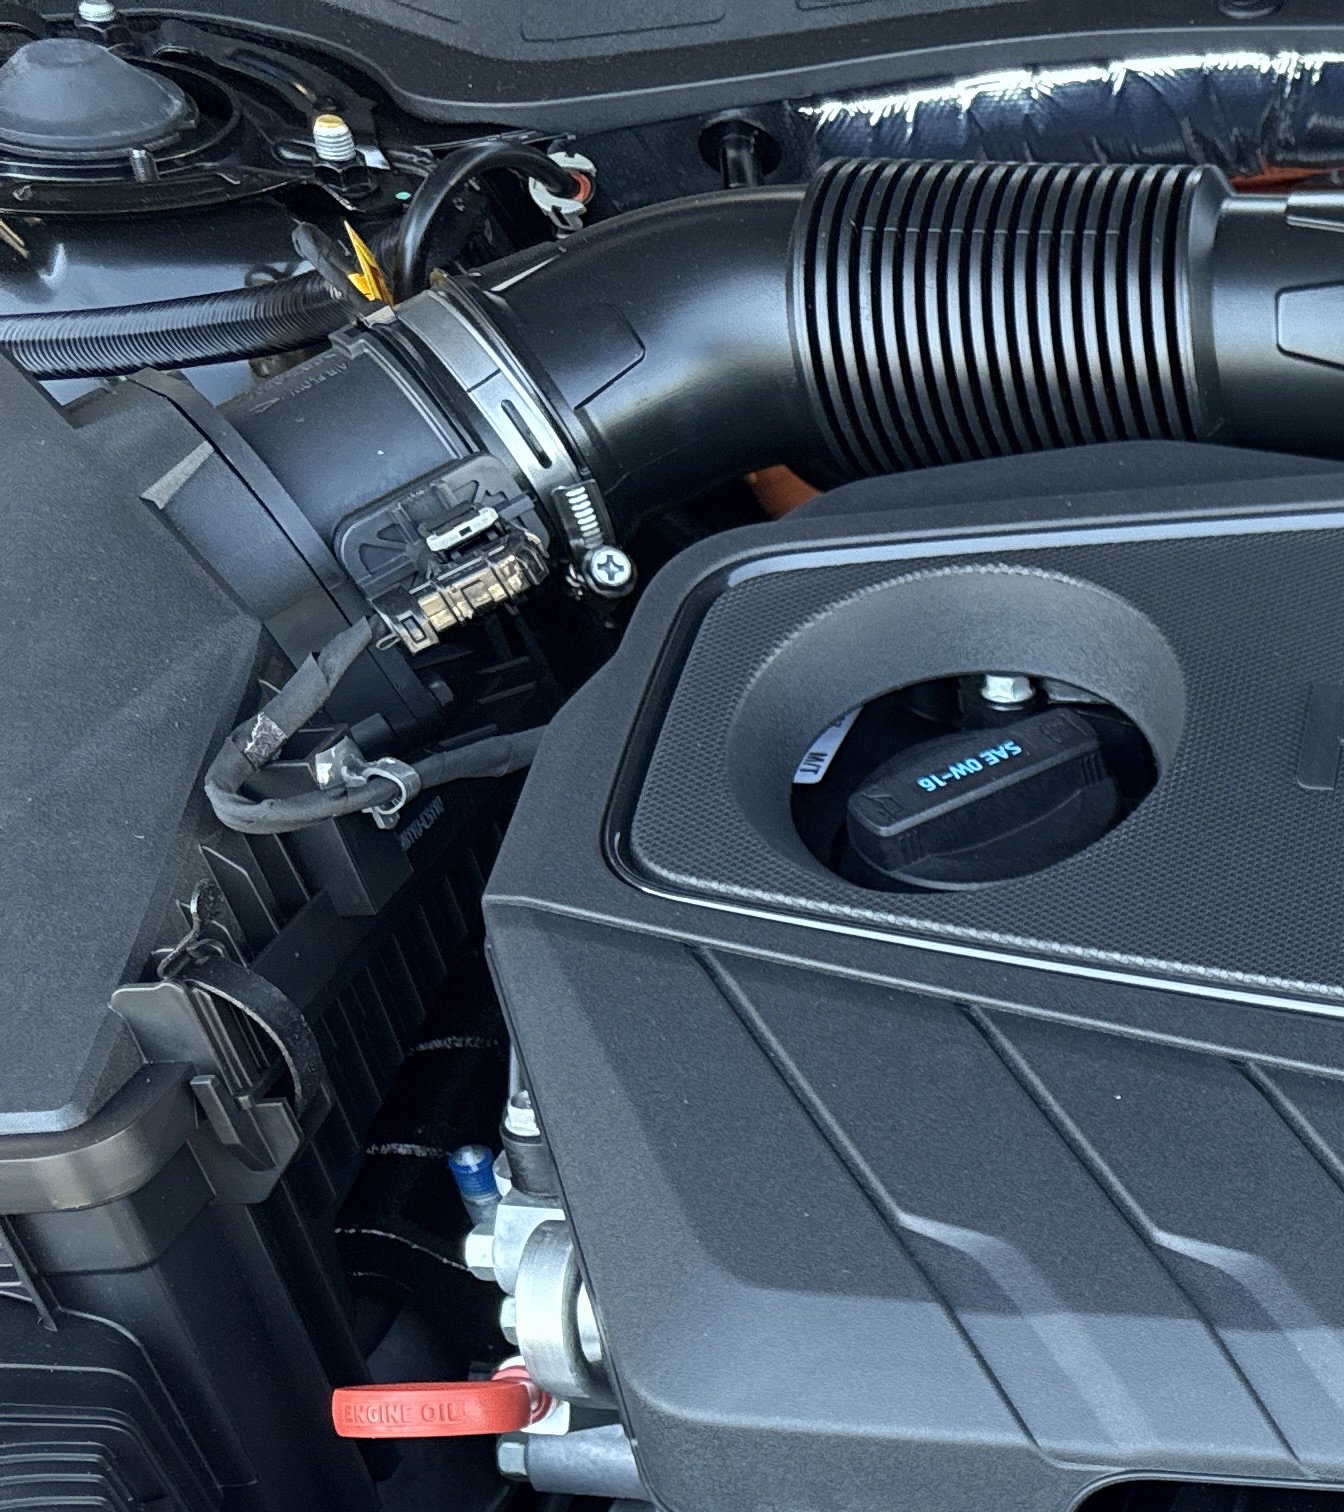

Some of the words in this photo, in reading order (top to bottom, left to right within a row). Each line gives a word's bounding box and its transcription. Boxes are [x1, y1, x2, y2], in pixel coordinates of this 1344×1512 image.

[979, 739, 1023, 769] SAE
[916, 755, 984, 793] 0W-16
[343, 1401, 411, 1425] ENGINE
[420, 1402, 462, 1423] OIL
